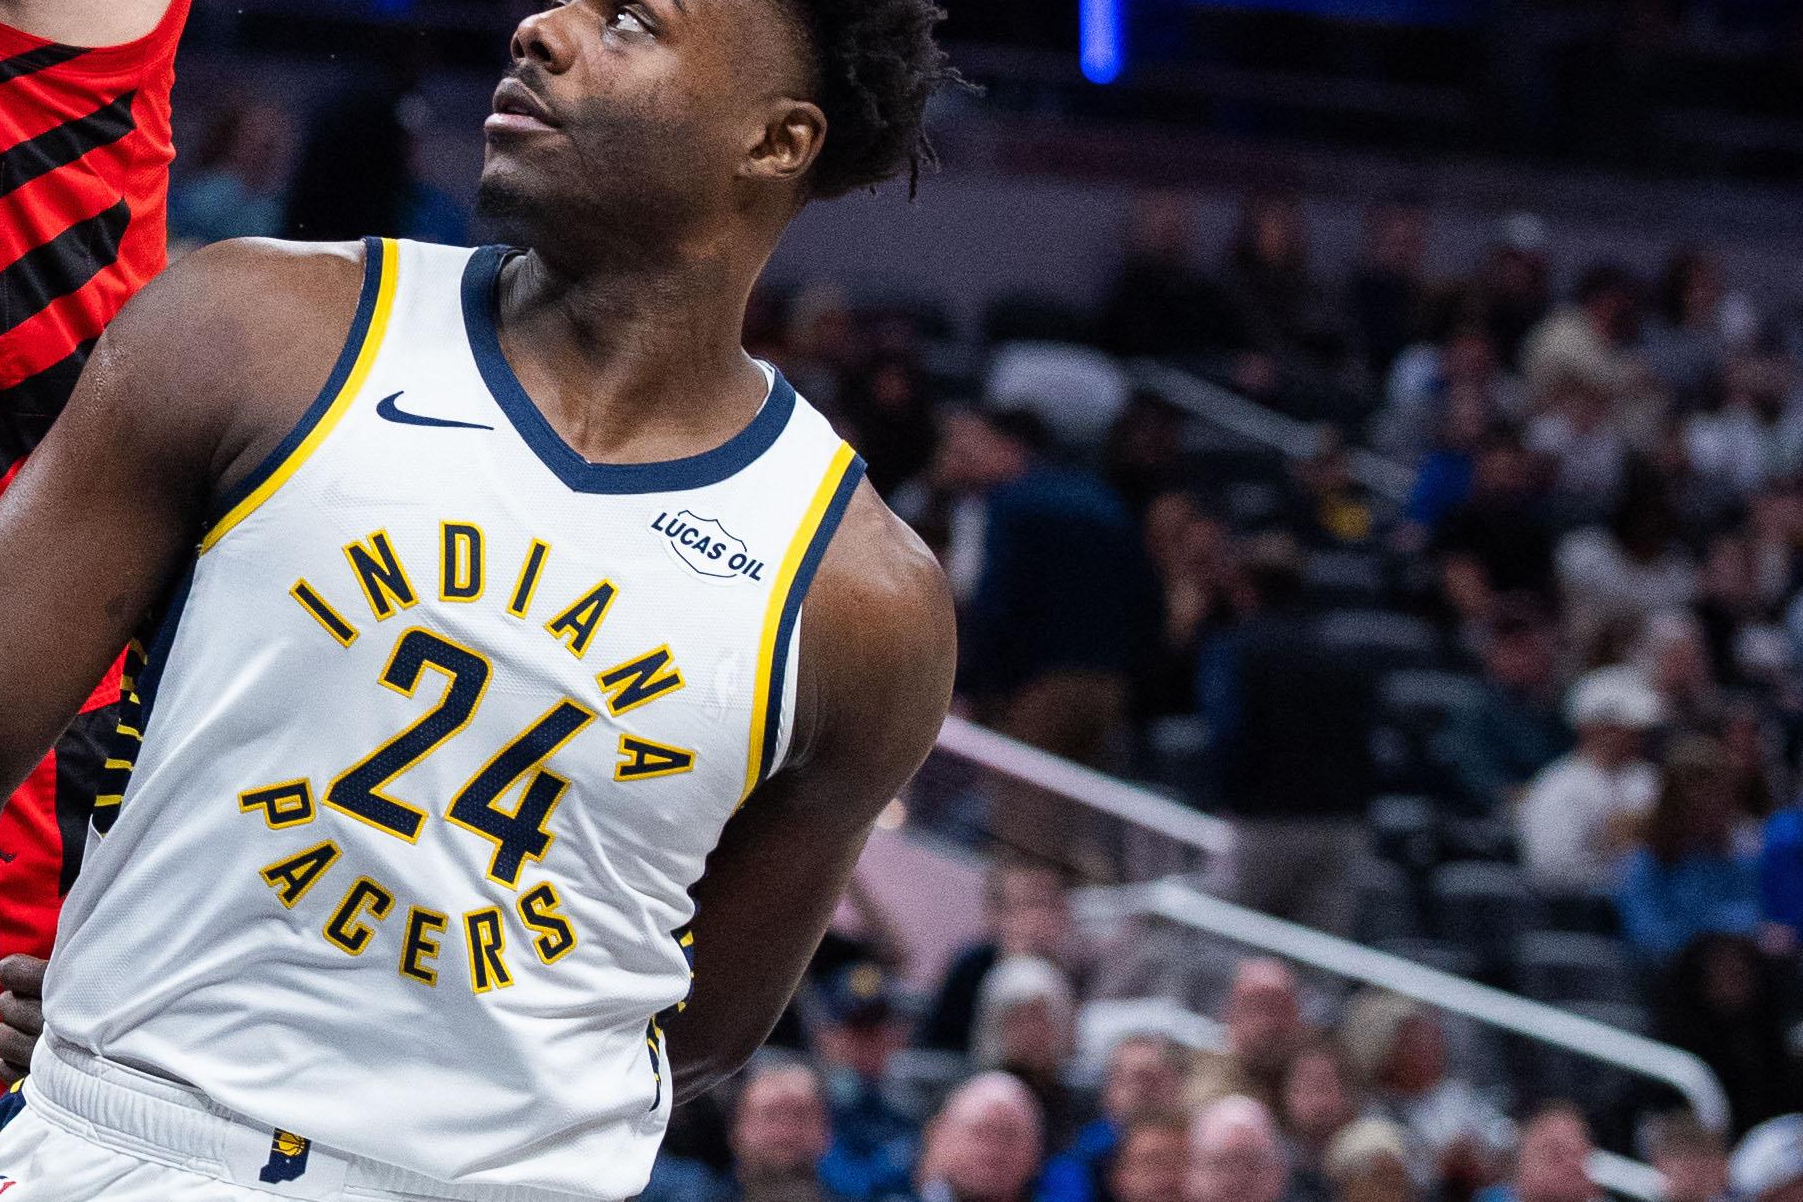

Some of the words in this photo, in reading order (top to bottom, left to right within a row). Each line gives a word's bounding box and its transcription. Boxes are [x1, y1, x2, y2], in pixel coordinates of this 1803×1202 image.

[289, 519, 696, 782] INDIANA
[650, 511, 727, 561] LUCAS
[727, 552, 765, 582] OIL
[322, 626, 598, 890] 24
[236, 776, 577, 995] PACERS
